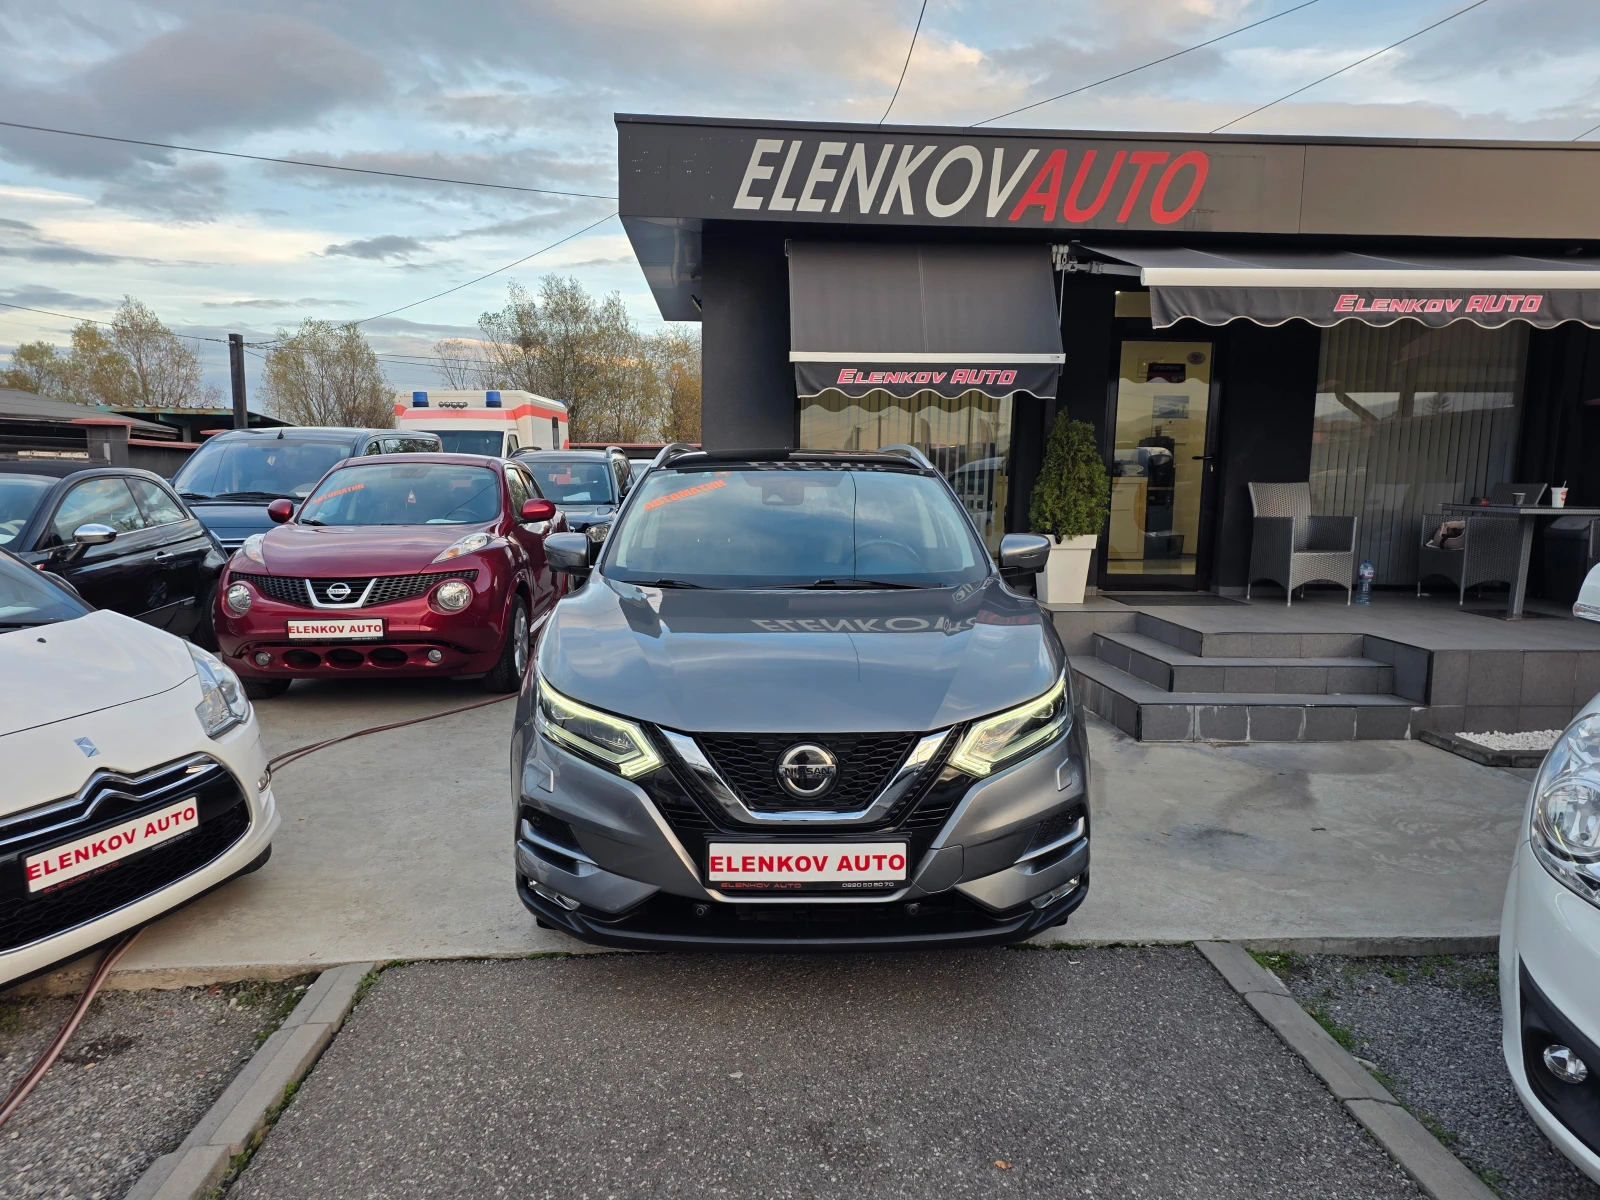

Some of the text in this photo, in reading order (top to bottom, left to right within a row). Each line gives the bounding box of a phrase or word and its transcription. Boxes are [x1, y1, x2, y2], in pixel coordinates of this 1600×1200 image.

[1333, 294, 1543, 313] ELENKOV AUTO
[837, 368, 1017, 385] ELENKOV AUTO
[288, 624, 382, 634] ELENKOV AUTO
[783, 767, 831, 775] NISSAN
[26, 828, 137, 881] ELENKOV
[143, 807, 195, 838] AUTO
[709, 854, 905, 872] ELENKOV AUTO
